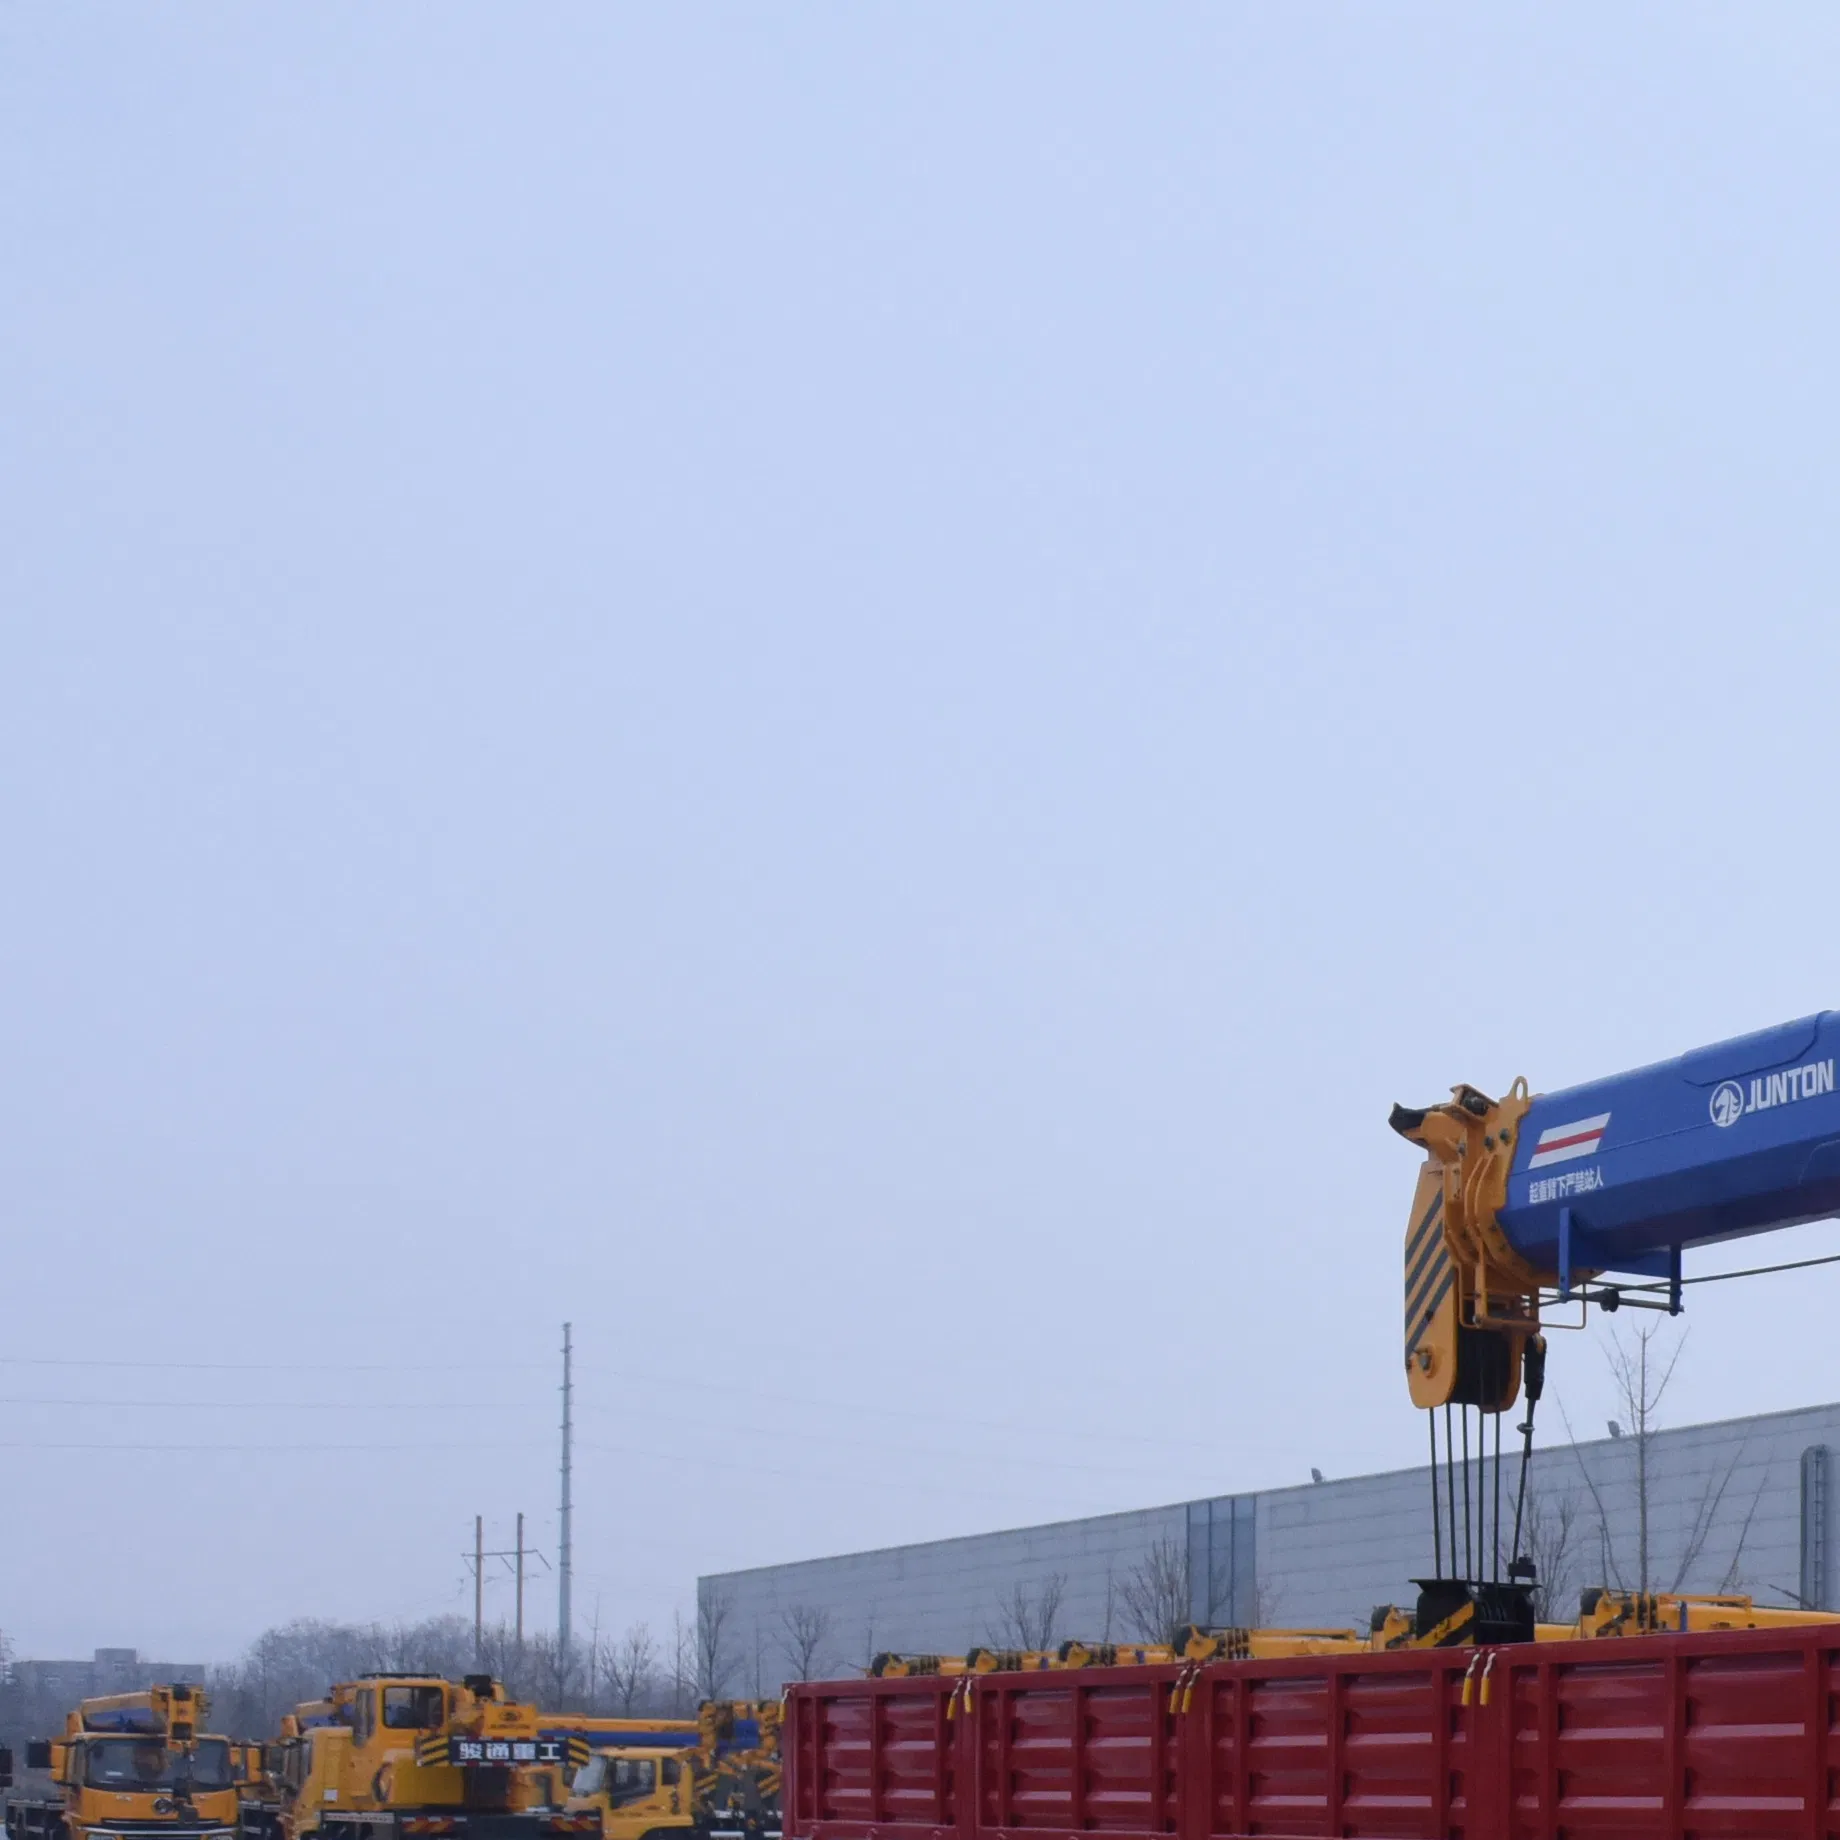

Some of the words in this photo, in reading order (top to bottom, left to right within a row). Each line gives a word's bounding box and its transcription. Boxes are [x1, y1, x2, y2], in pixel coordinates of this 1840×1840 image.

[1745, 1058, 1834, 1114] JUNTON
[1528, 1164, 1604, 1205] 起重臂下严禁站人
[459, 1742, 561, 1760] 骏通重工
